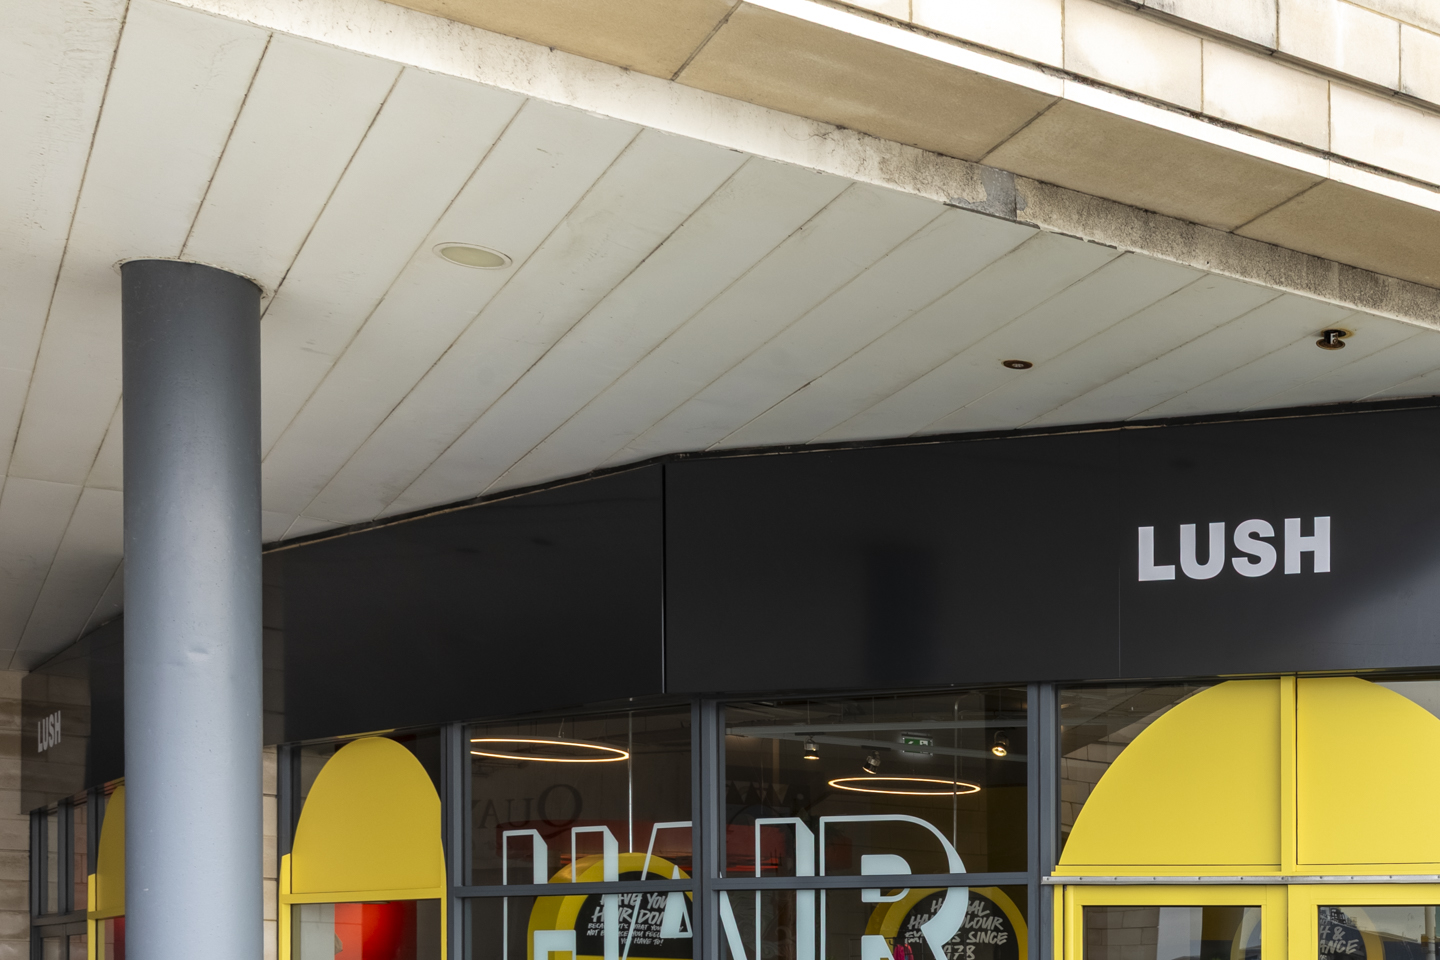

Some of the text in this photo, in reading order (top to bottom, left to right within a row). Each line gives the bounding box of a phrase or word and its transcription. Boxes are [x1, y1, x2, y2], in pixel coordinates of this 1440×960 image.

[1137, 515, 1332, 582] LUSH
[37, 709, 61, 753] LUSH
[966, 930, 1009, 946] SINCE
